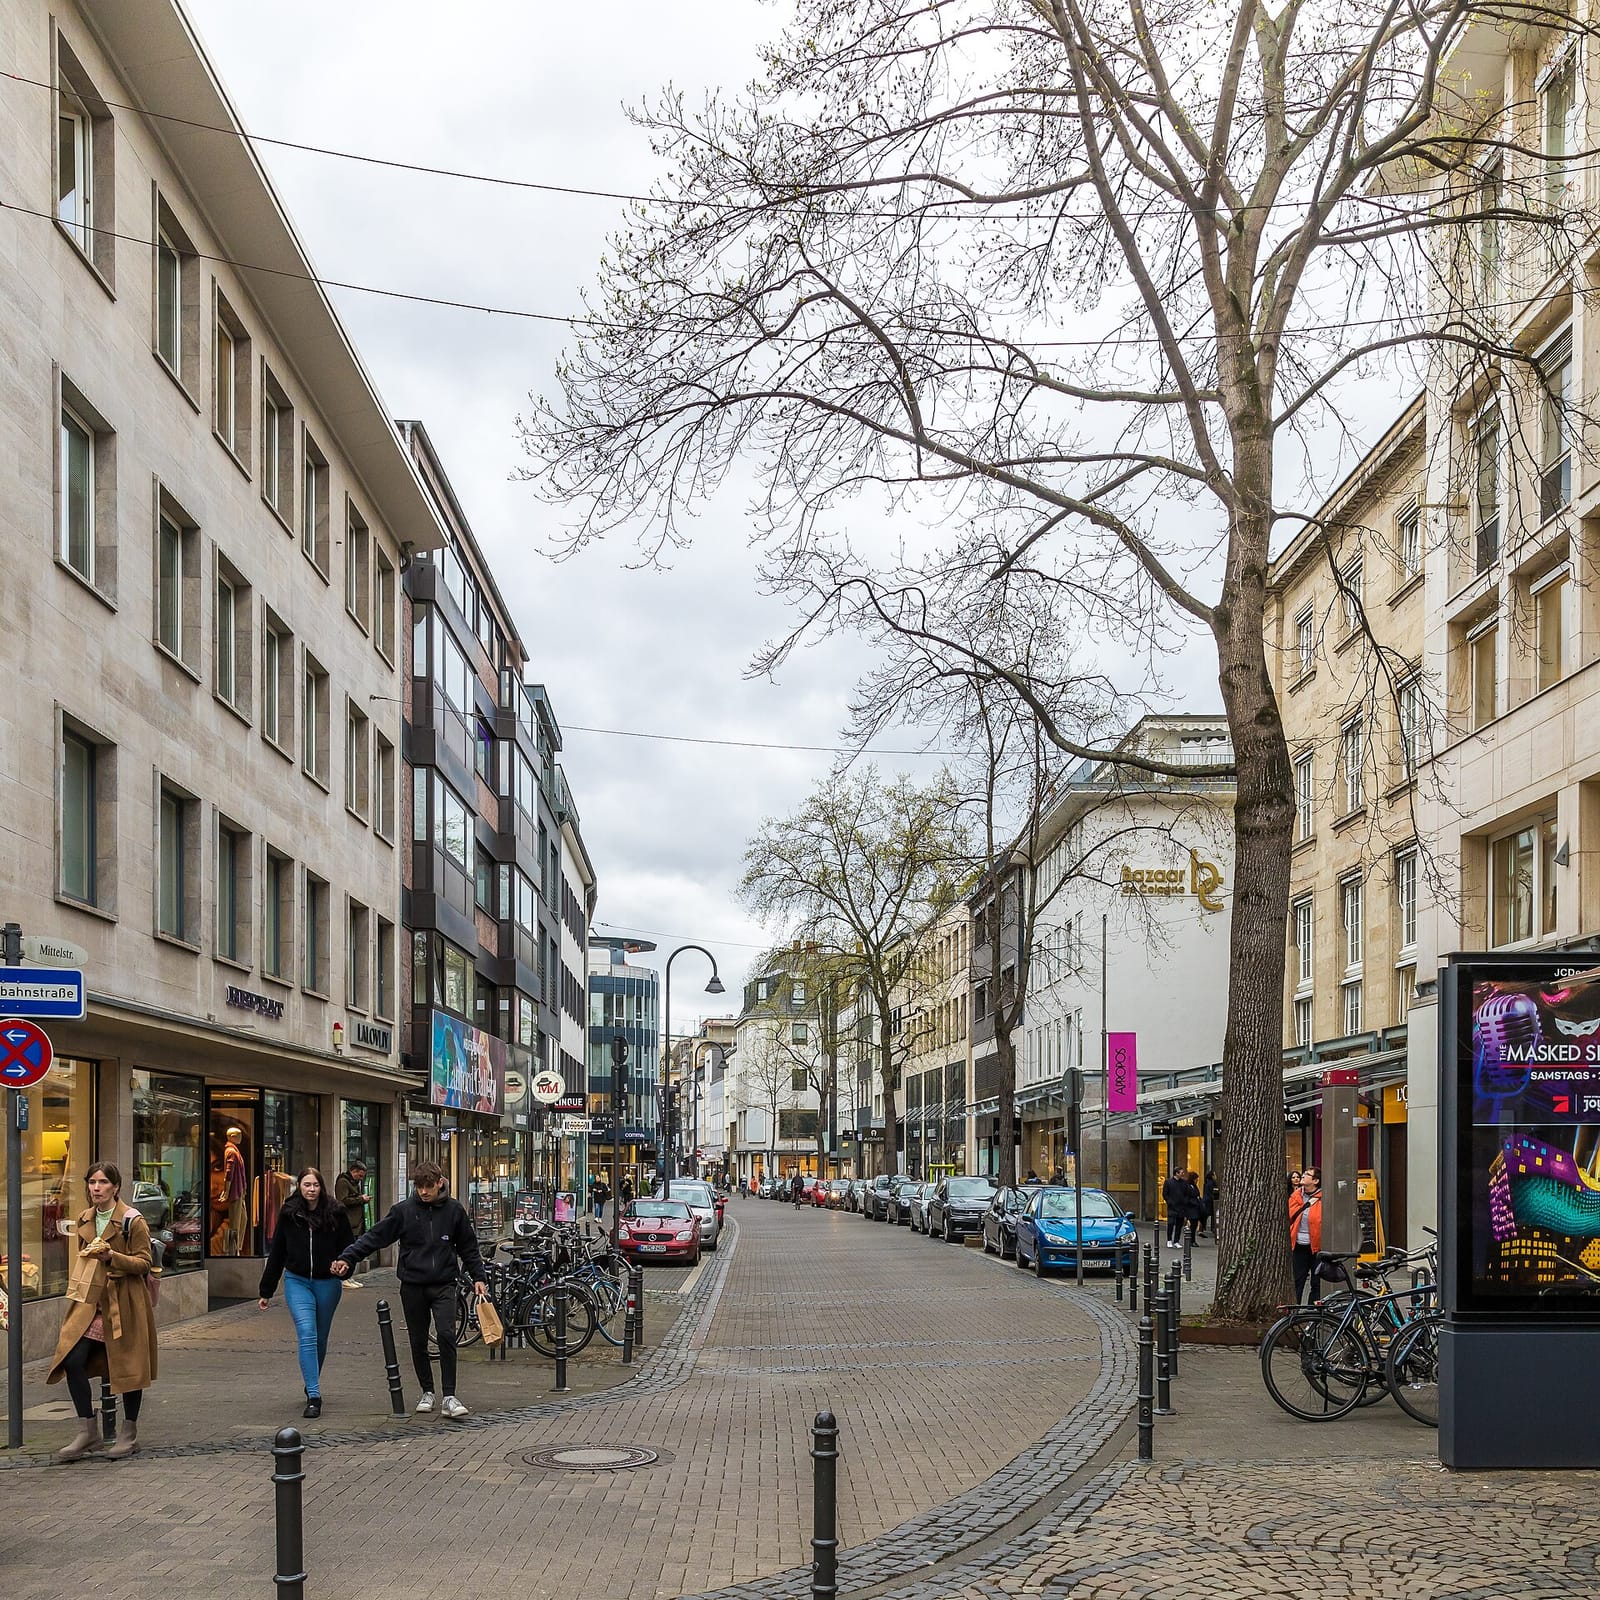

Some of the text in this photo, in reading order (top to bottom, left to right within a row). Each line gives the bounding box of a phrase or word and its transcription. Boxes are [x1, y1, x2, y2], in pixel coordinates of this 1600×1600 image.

[39, 944, 74, 960] Mittelstr.
[1499, 1044, 1507, 1061] THE
[1507, 1044, 1581, 1062] MASKED
[1115, 1047, 1127, 1096] APROPOS
[1530, 1071, 1590, 1080] SAMSTAGS
